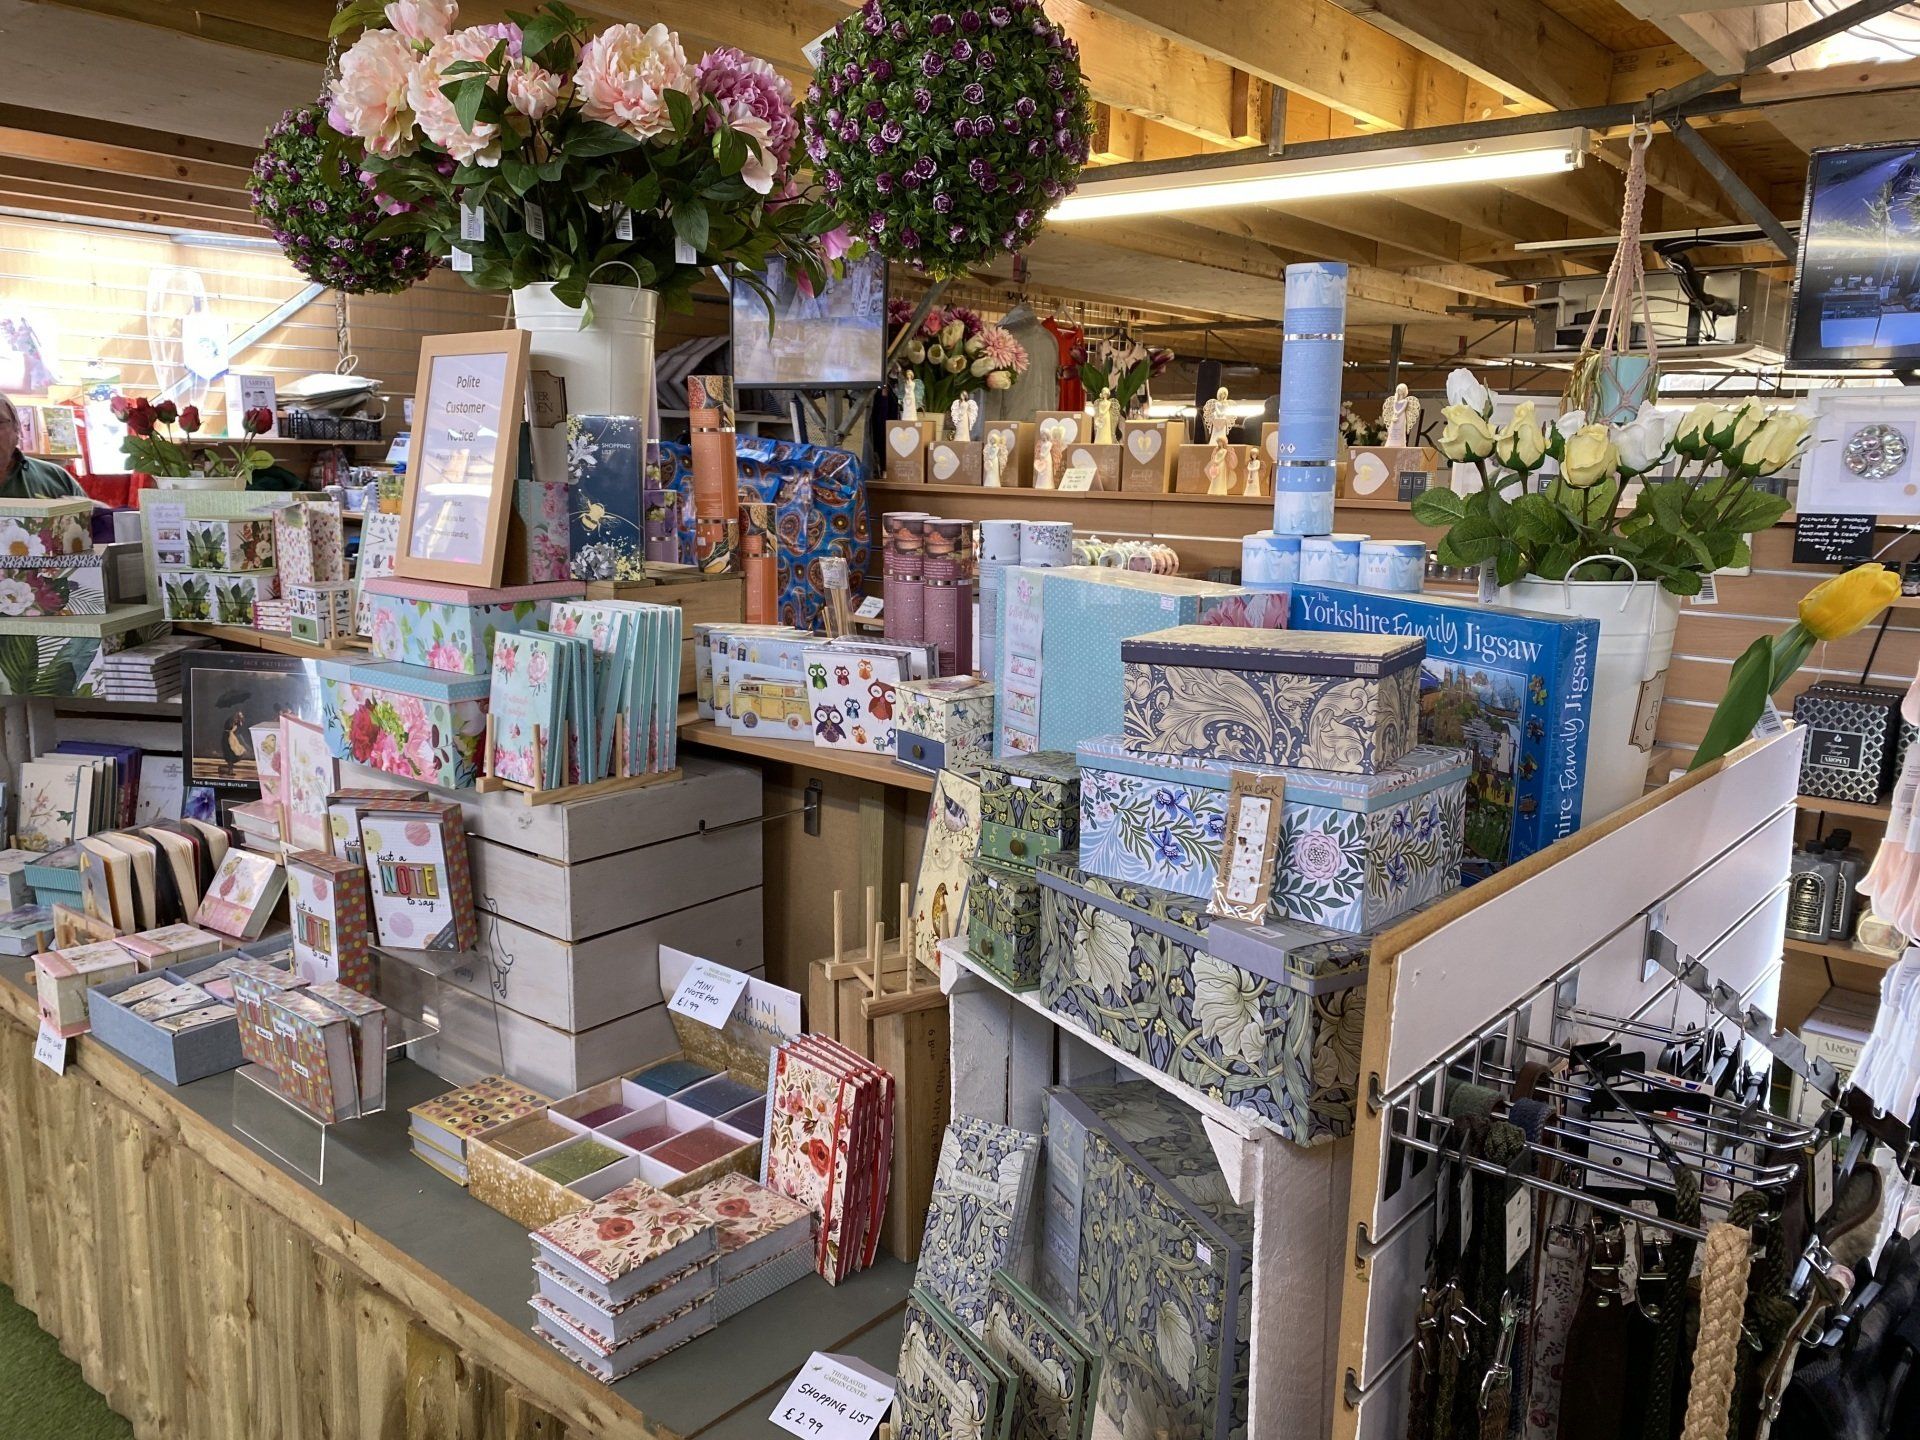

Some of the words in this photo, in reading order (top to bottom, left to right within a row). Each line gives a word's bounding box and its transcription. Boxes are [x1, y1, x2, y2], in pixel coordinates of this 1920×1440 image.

[456, 375, 481, 388] Polite
[445, 400, 486, 414] Customer
[1316, 592, 1330, 602] The
[1300, 594, 1390, 635] Yorkshire
[1392, 612, 1458, 654] Family
[1463, 622, 1544, 664] Jigsaw
[1564, 631, 1590, 712] Jigsaw
[1559, 717, 1585, 792] Family
[1234, 782, 1252, 793] Alex
[376, 851, 394, 865] just
[380, 865, 438, 897] NOTE
[406, 896, 416, 906] to
[298, 912, 330, 953] NOTE
[694, 980, 715, 993] MINI
[744, 994, 777, 1017] MINI
[824, 1374, 846, 1388] GARDEN
[798, 1383, 848, 1416] SHOPPING
[848, 1409, 874, 1426] LIST
